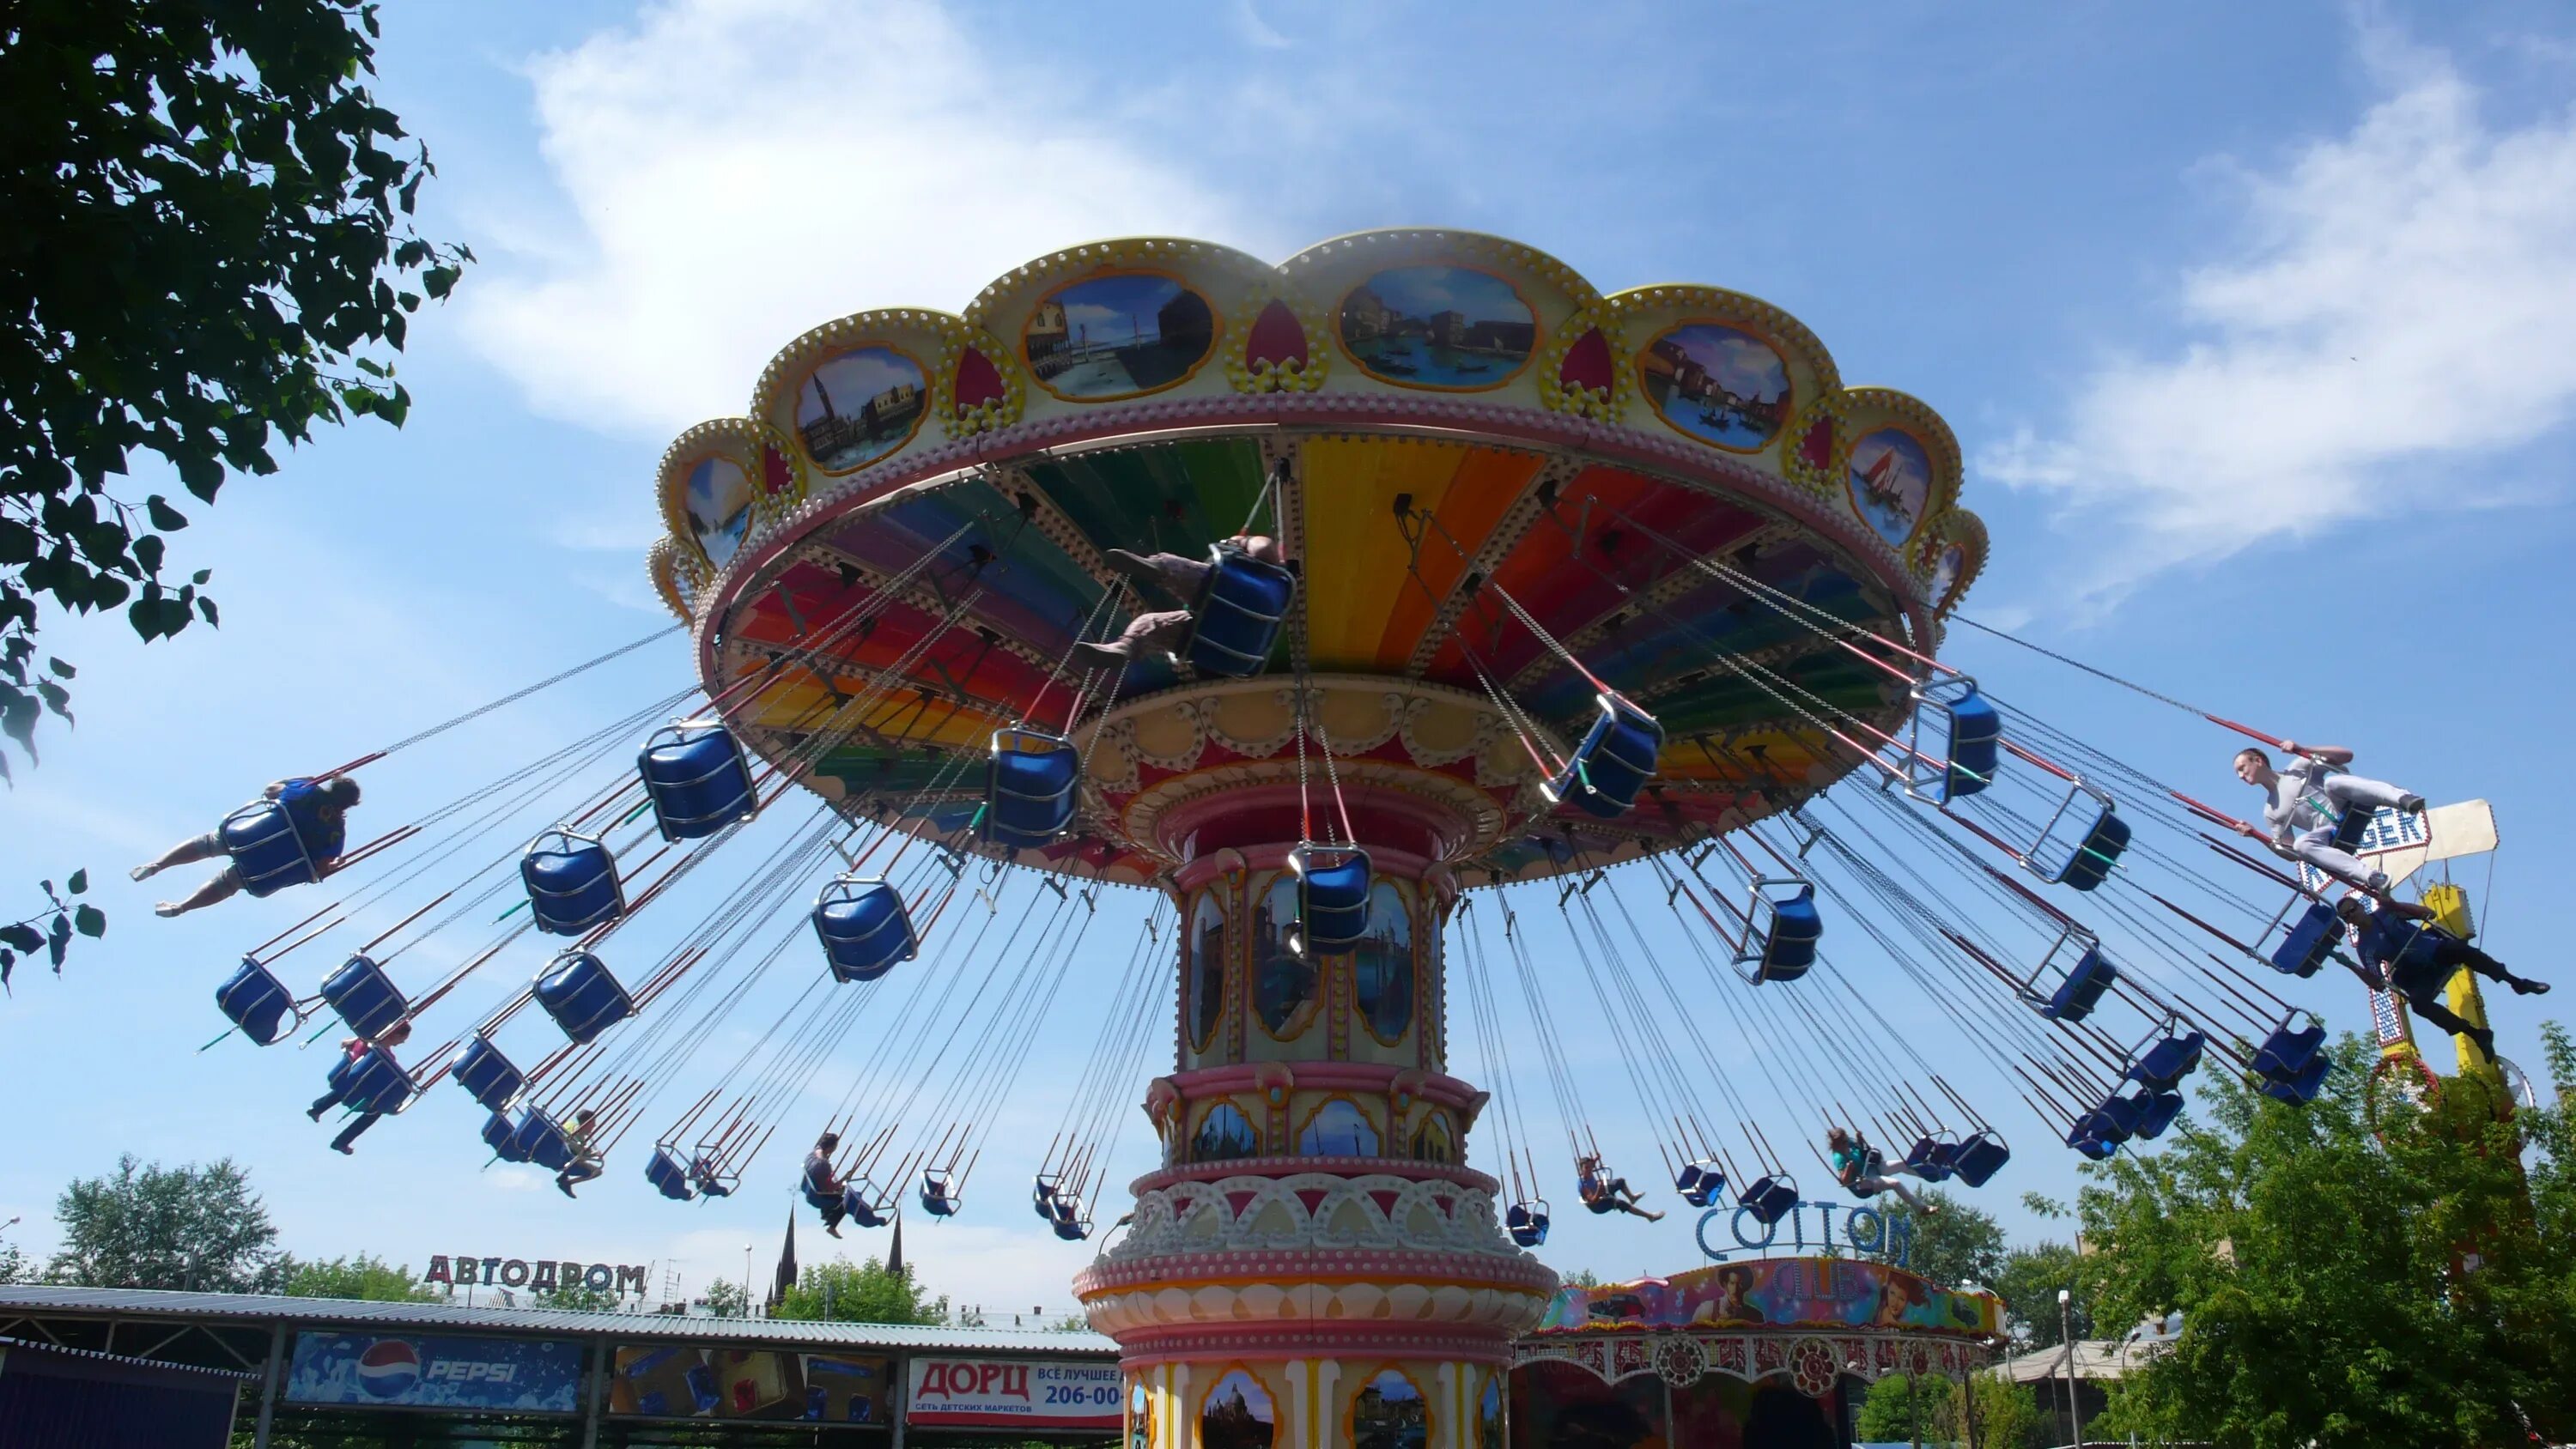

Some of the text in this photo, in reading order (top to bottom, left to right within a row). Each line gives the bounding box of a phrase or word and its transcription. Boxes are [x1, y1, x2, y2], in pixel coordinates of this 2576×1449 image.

[1696, 1200, 1911, 1267] COTTON
[424, 1254, 647, 1294] АВТОДРОМ
[1772, 1260, 1859, 1300] CLUB
[428, 1361, 517, 1383] PEPSI
[917, 1362, 1030, 1402] ДОРЦ
[1037, 1367, 1061, 1380] ВСЁ
[1063, 1368, 1117, 1381] ЛУЧШЕЕ
[915, 1403, 1032, 1413] СЕТЬ ДЕТСКИХ МАРКЕТОВ
